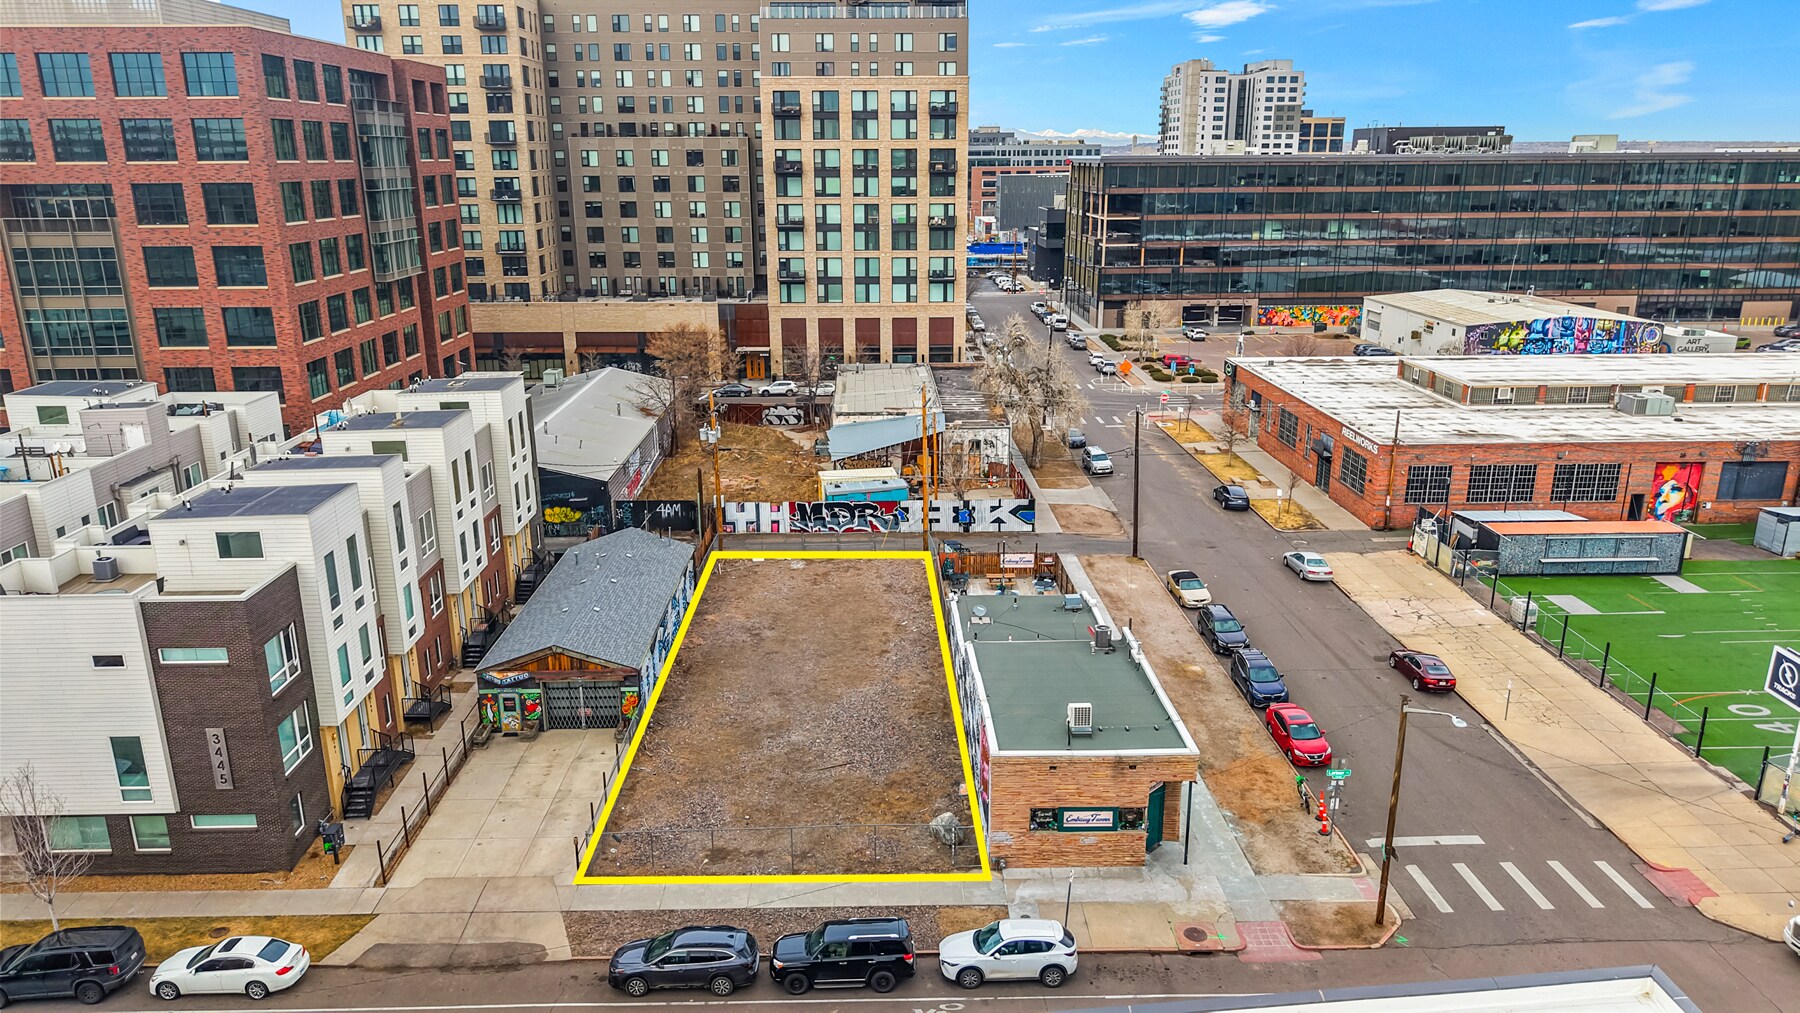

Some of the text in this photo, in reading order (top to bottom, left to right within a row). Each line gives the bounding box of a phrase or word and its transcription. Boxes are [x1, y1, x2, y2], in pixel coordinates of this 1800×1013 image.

[1341, 426, 1379, 455] REELWORKS
[656, 503, 682, 518] 4AM
[501, 672, 529, 685] TATTOO
[1773, 681, 1796, 700] TRACKS
[211, 733, 228, 785] 3445
